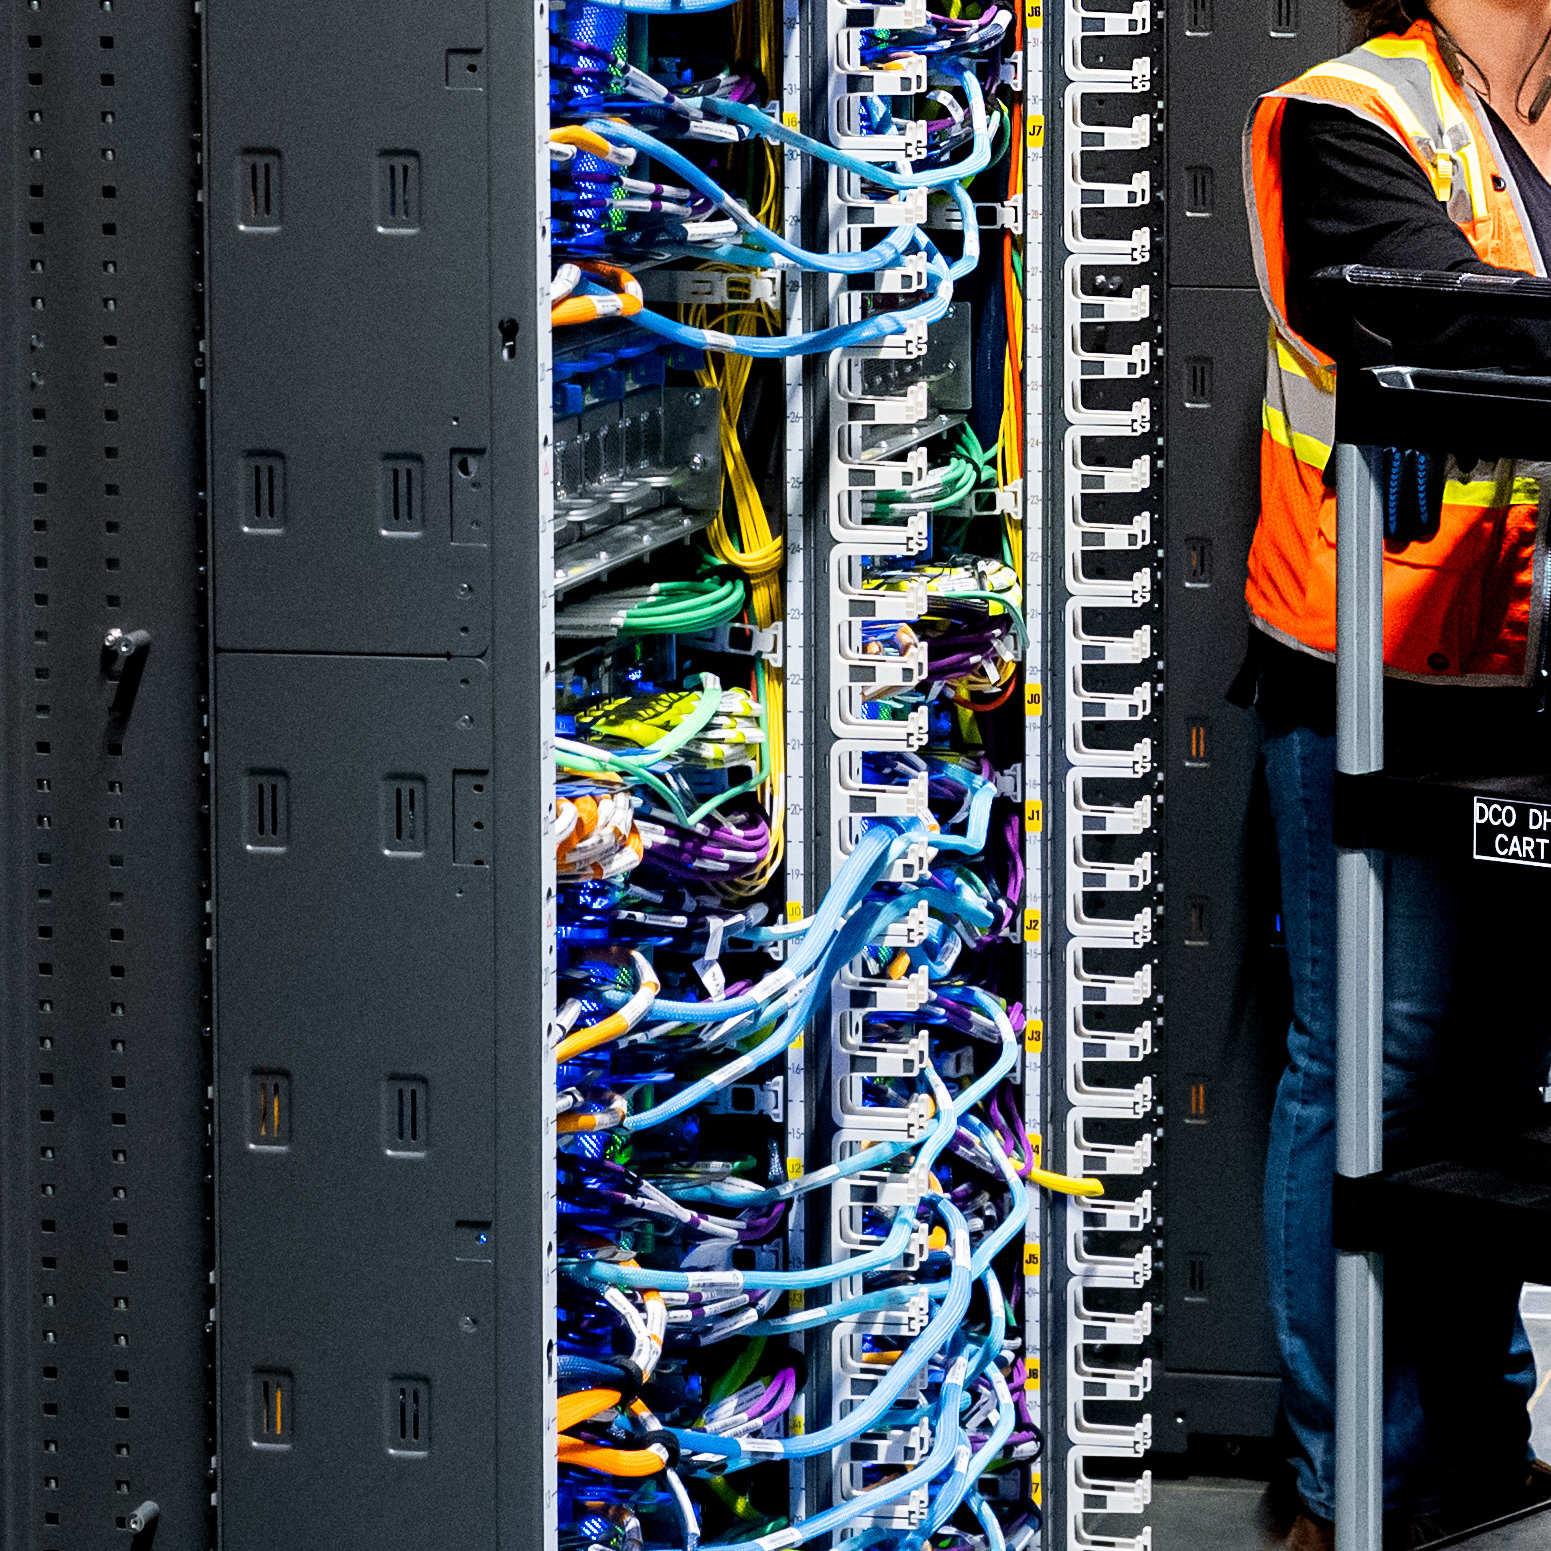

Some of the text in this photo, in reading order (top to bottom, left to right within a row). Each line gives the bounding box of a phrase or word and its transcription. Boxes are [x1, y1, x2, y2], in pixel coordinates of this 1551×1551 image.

[1028, 6, 1041, 17] J6
[1032, 37, 1041, 46] 31
[788, 83, 797, 94] 31
[787, 117, 798, 127] J6
[1029, 125, 1042, 136] J7
[788, 149, 798, 160] 30
[1031, 152, 1040, 161] 29
[789, 215, 799, 226] 29
[1031, 267, 1040, 276] 27
[1030, 324, 1039, 333] 26
[1030, 381, 1039, 390] 25
[790, 411, 800, 422] 26
[1030, 438, 1039, 447] 24
[791, 477, 800, 488] 25
[1030, 495, 1039, 504] 23
[791, 542, 800, 553] 24
[1030, 552, 1039, 561] 22
[791, 608, 801, 619] 23
[1030, 609, 1039, 618] 21
[1030, 666, 1039, 675] 20
[790, 674, 800, 684] 22
[1027, 693, 1040, 704] J0
[1029, 722, 1038, 731] 19
[791, 739, 799, 750] 21
[1029, 779, 1038, 788] 18
[791, 804, 800, 815] 20
[1475, 802, 1516, 827] DCO
[1028, 810, 1040, 821] J1
[1029, 835, 1038, 844] 17
[1495, 833, 1549, 860] CART
[791, 868, 800, 879] 19
[1029, 892, 1038, 901] 16
[790, 907, 801, 916] J0
[1026, 919, 1039, 931] J2
[1029, 949, 1038, 958] 15
[1029, 1006, 1038, 1015] 14
[1028, 1030, 1041, 1042] J3
[791, 1063, 801, 1074] 16
[1029, 1119, 1038, 1128] 12
[792, 1128, 801, 1139] 15
[789, 1164, 801, 1173] J2
[1025, 1253, 1039, 1264] J5
[791, 1293, 802, 1303] J3
[1027, 1368, 1038, 1379] J6
[790, 1420, 801, 1429] J4
